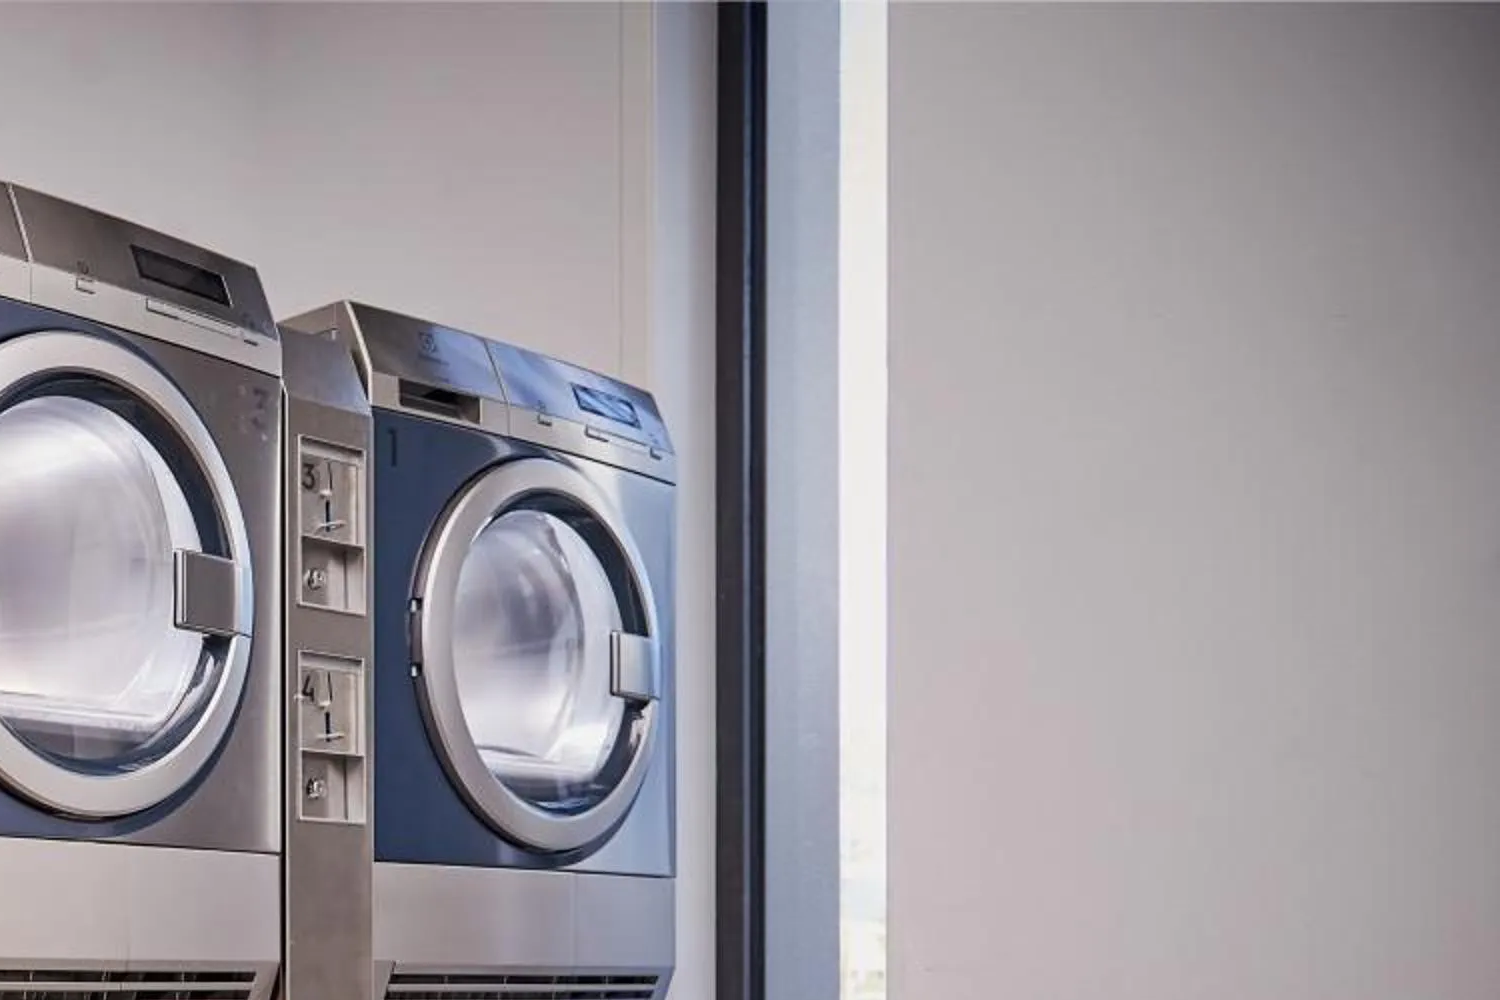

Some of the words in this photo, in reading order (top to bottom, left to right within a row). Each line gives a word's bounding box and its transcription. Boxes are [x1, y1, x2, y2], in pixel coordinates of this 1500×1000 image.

[387, 427, 398, 468] 1
[301, 462, 316, 491] 3
[301, 674, 315, 703] 4
